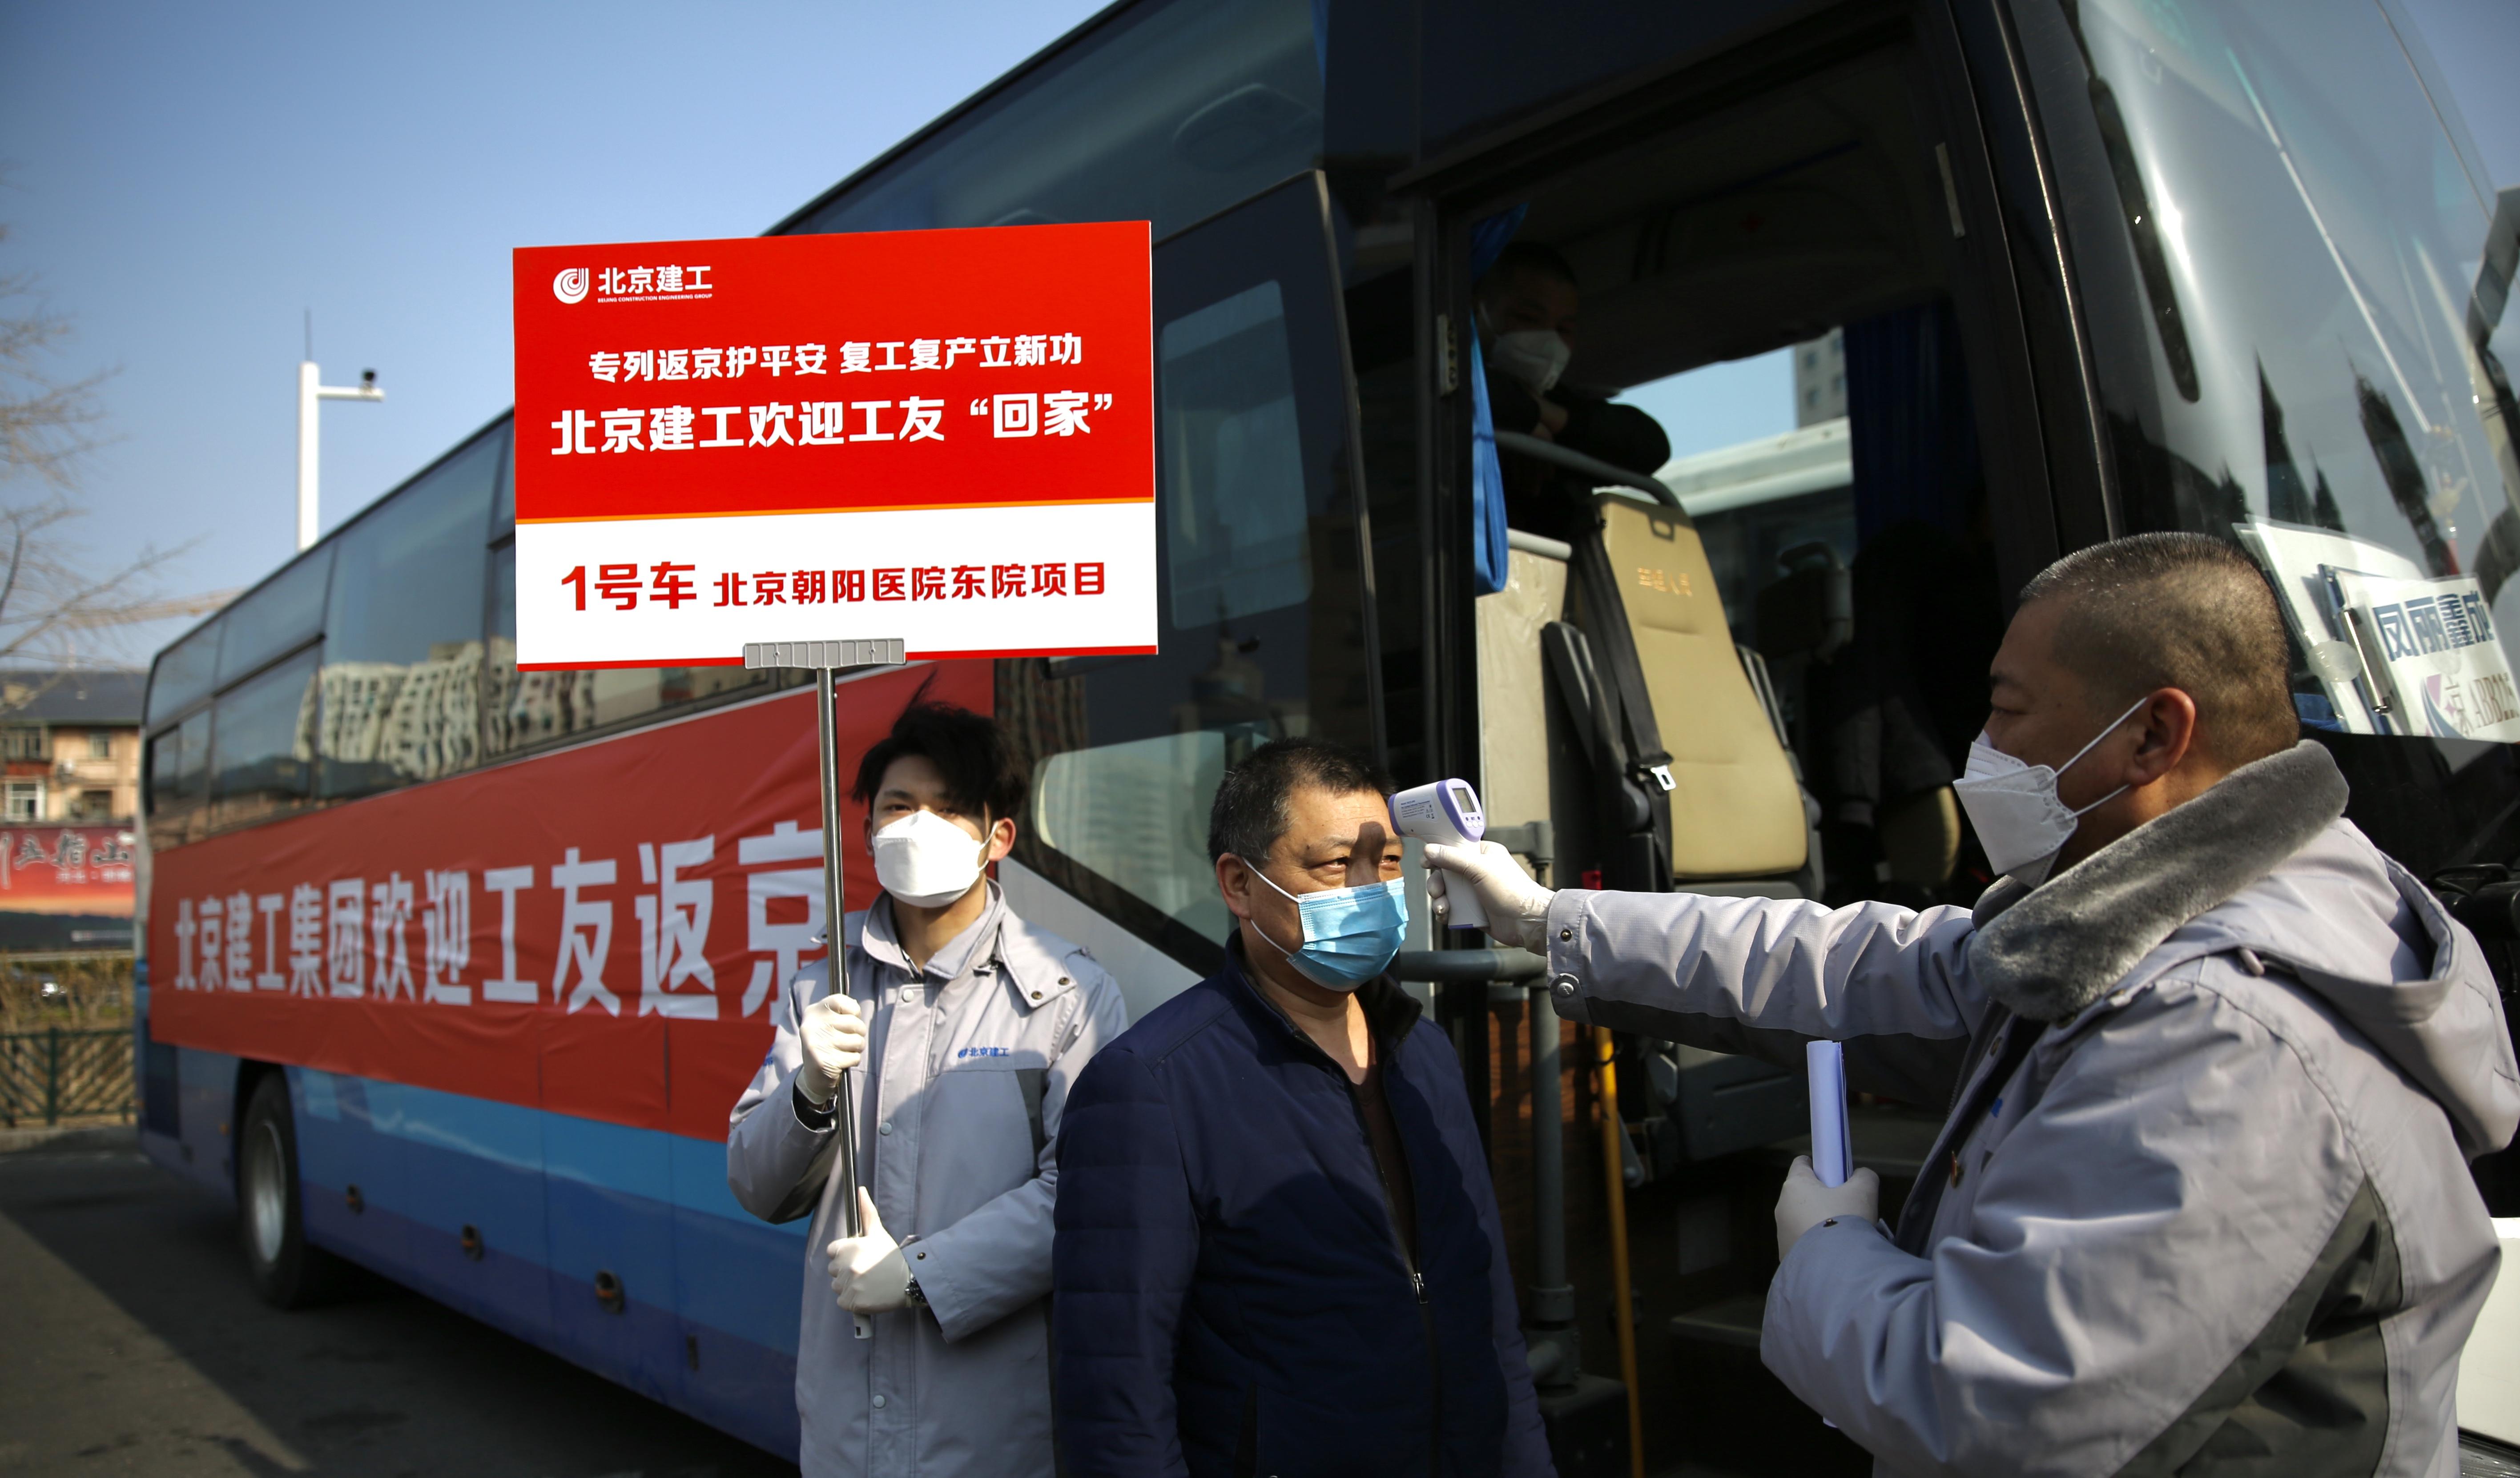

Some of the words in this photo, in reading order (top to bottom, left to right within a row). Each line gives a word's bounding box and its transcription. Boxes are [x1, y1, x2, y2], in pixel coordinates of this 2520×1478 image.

[598, 264, 713, 294] 北京建工
[588, 343, 827, 383] 专列返京护平安
[840, 332, 1082, 374] 复工复产立新功
[561, 561, 697, 611] 1号车
[713, 562, 1106, 607] 北京朝阳医院东院项目
[174, 819, 825, 1026] 北京建工集团欢迎工友返京
[969, 1047, 1010, 1058] 北京建工
